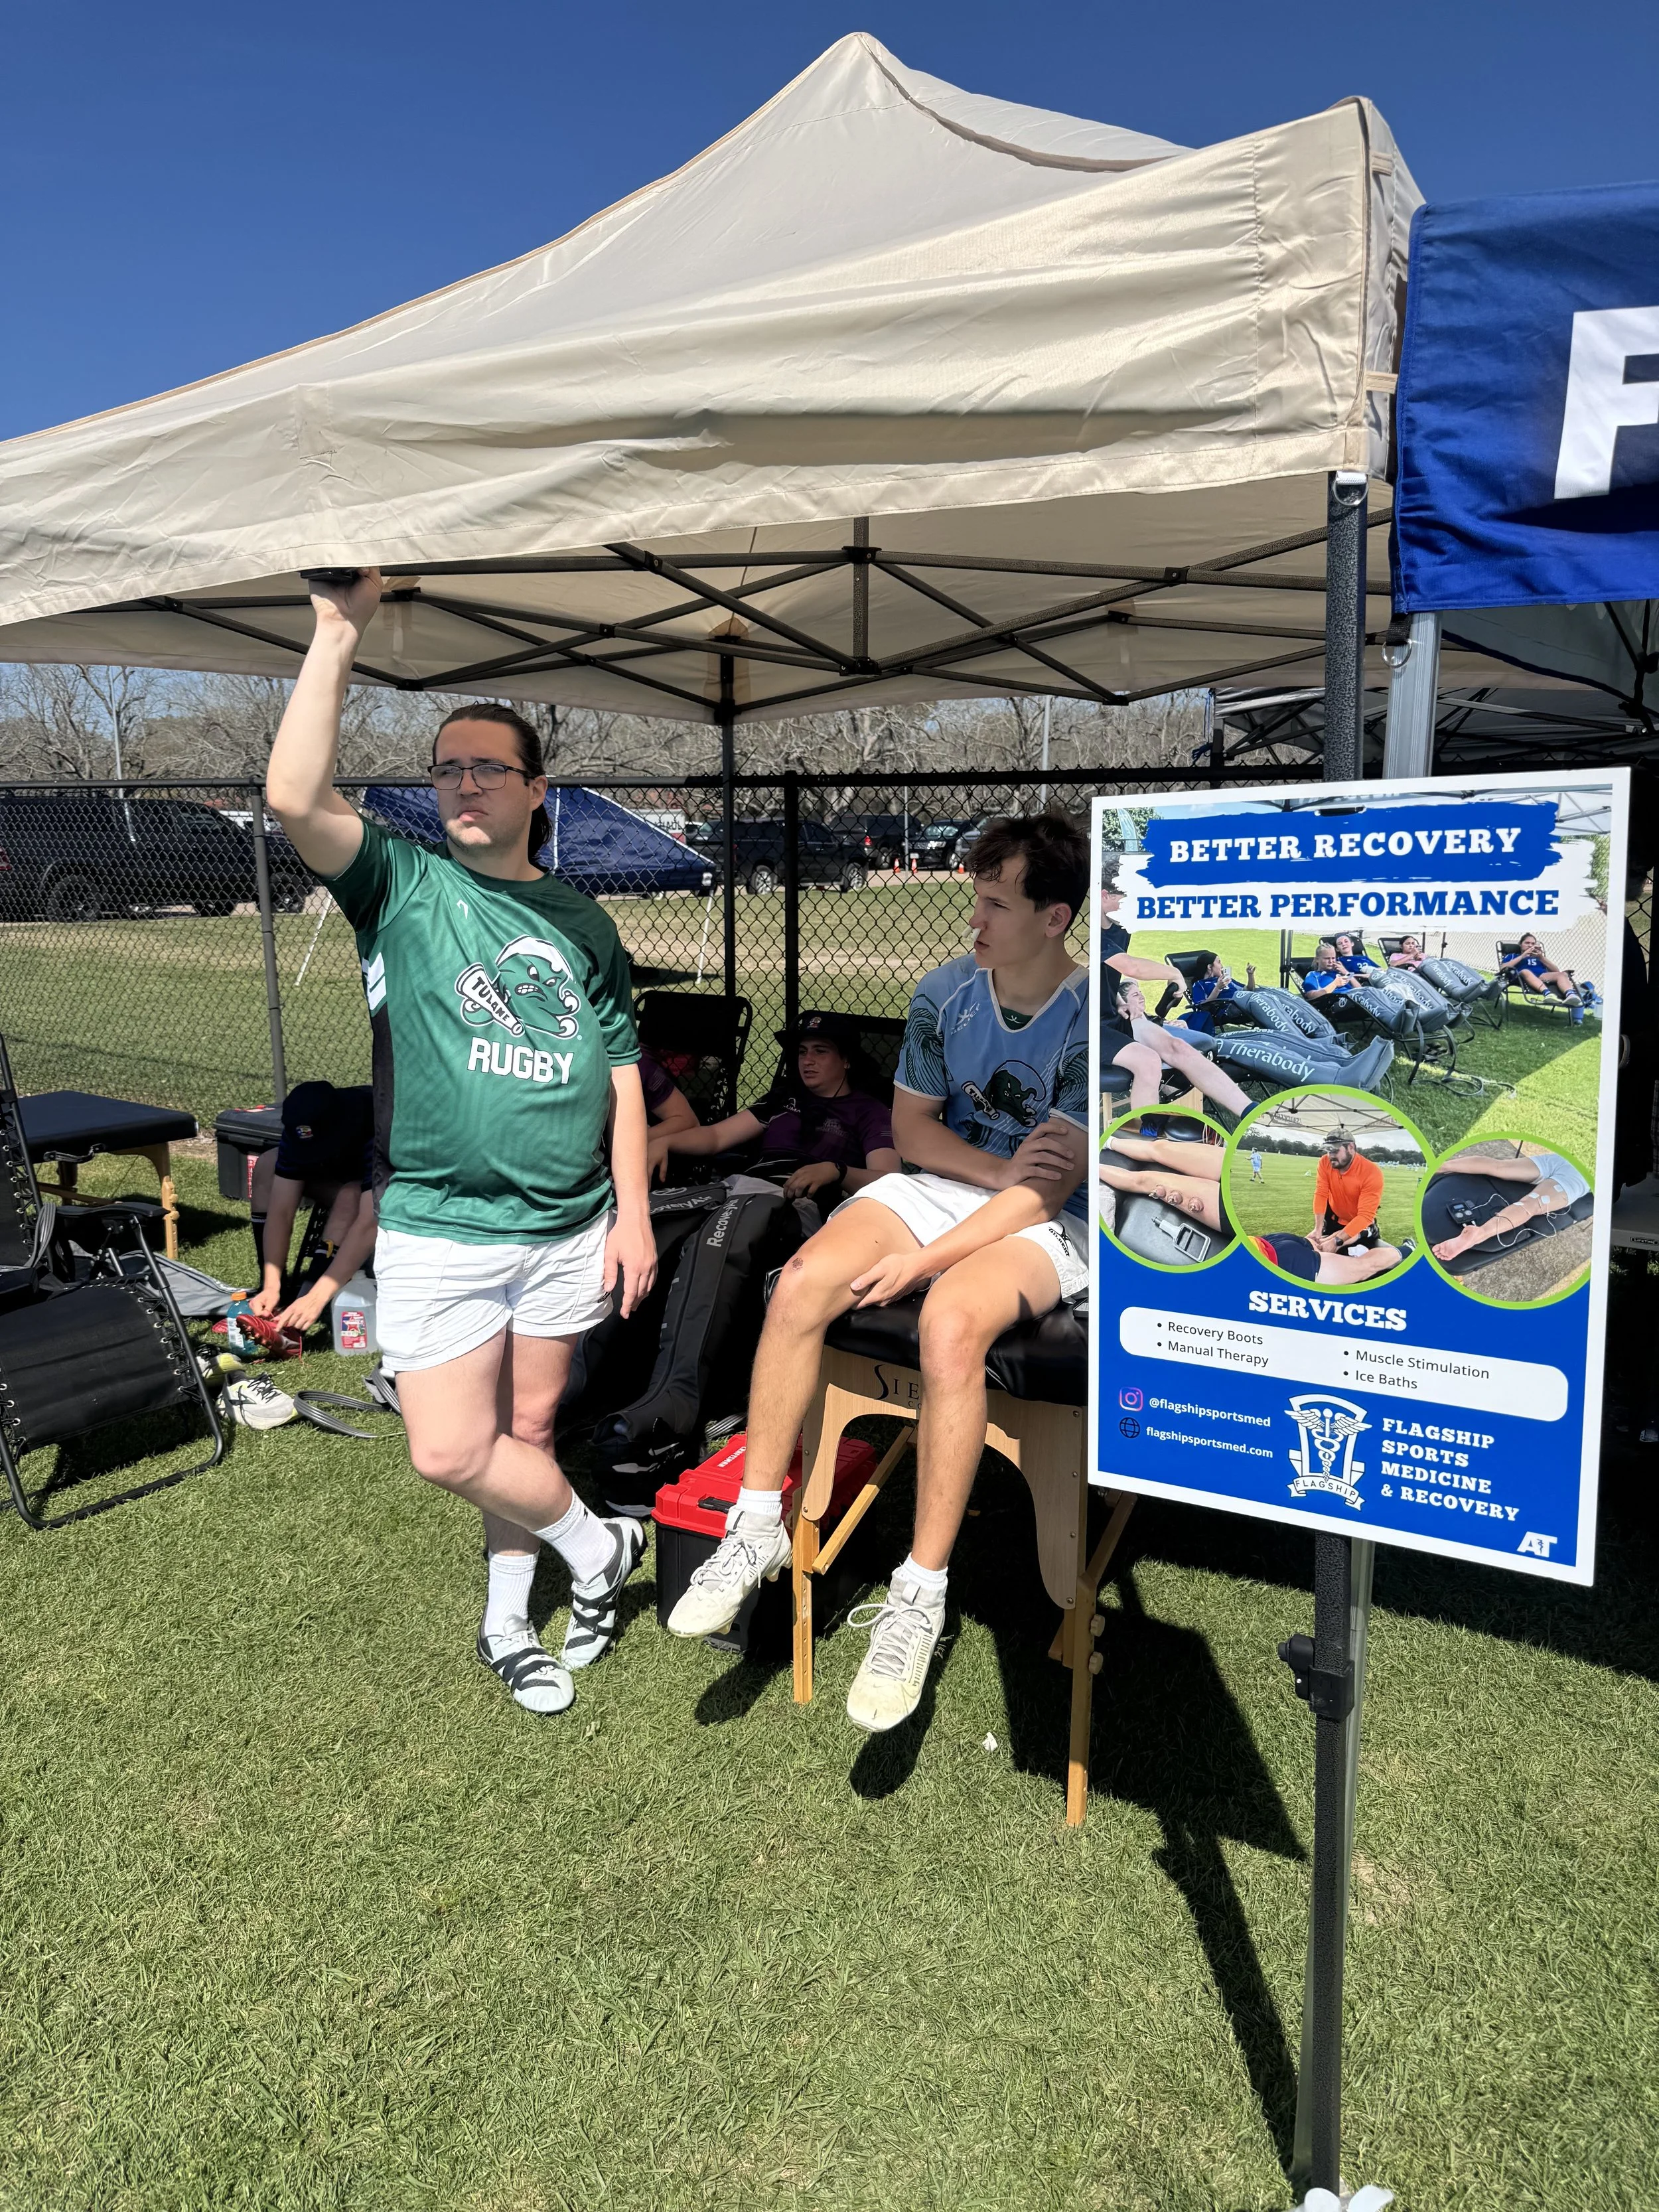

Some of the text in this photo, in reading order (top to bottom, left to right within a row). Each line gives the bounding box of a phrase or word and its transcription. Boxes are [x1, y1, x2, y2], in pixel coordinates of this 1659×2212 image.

[1170, 827, 1522, 863] BETTER RECOVERY
[1136, 889, 1559, 919] BETTER PERFORMANCE
[470, 976, 510, 1023] TULANE
[467, 1036, 575, 1084] RUGBY
[1229, 1040, 1315, 1082] Therabody
[1249, 1290, 1407, 1331] SERVICES
[1168, 1321, 1263, 1345] Recovery Boots
[1168, 1341, 1269, 1368] Manual Therapy
[1356, 1350, 1490, 1379] Muscle Stimulation
[1356, 1370, 1418, 1389] Ice Baths
[1149, 1398, 1271, 1427] @flagshipsportsmed
[1146, 1426, 1273, 1458] flagshipsportsmed.com
[1382, 1418, 1494, 1449] FLAGSHIP
[1382, 1439, 1469, 1467] SPORTS
[1295, 1480, 1356, 1497] FLAGSHIP
[1381, 1461, 1492, 1494] MEDICINE
[1381, 1483, 1520, 1521] & RECOVERY
